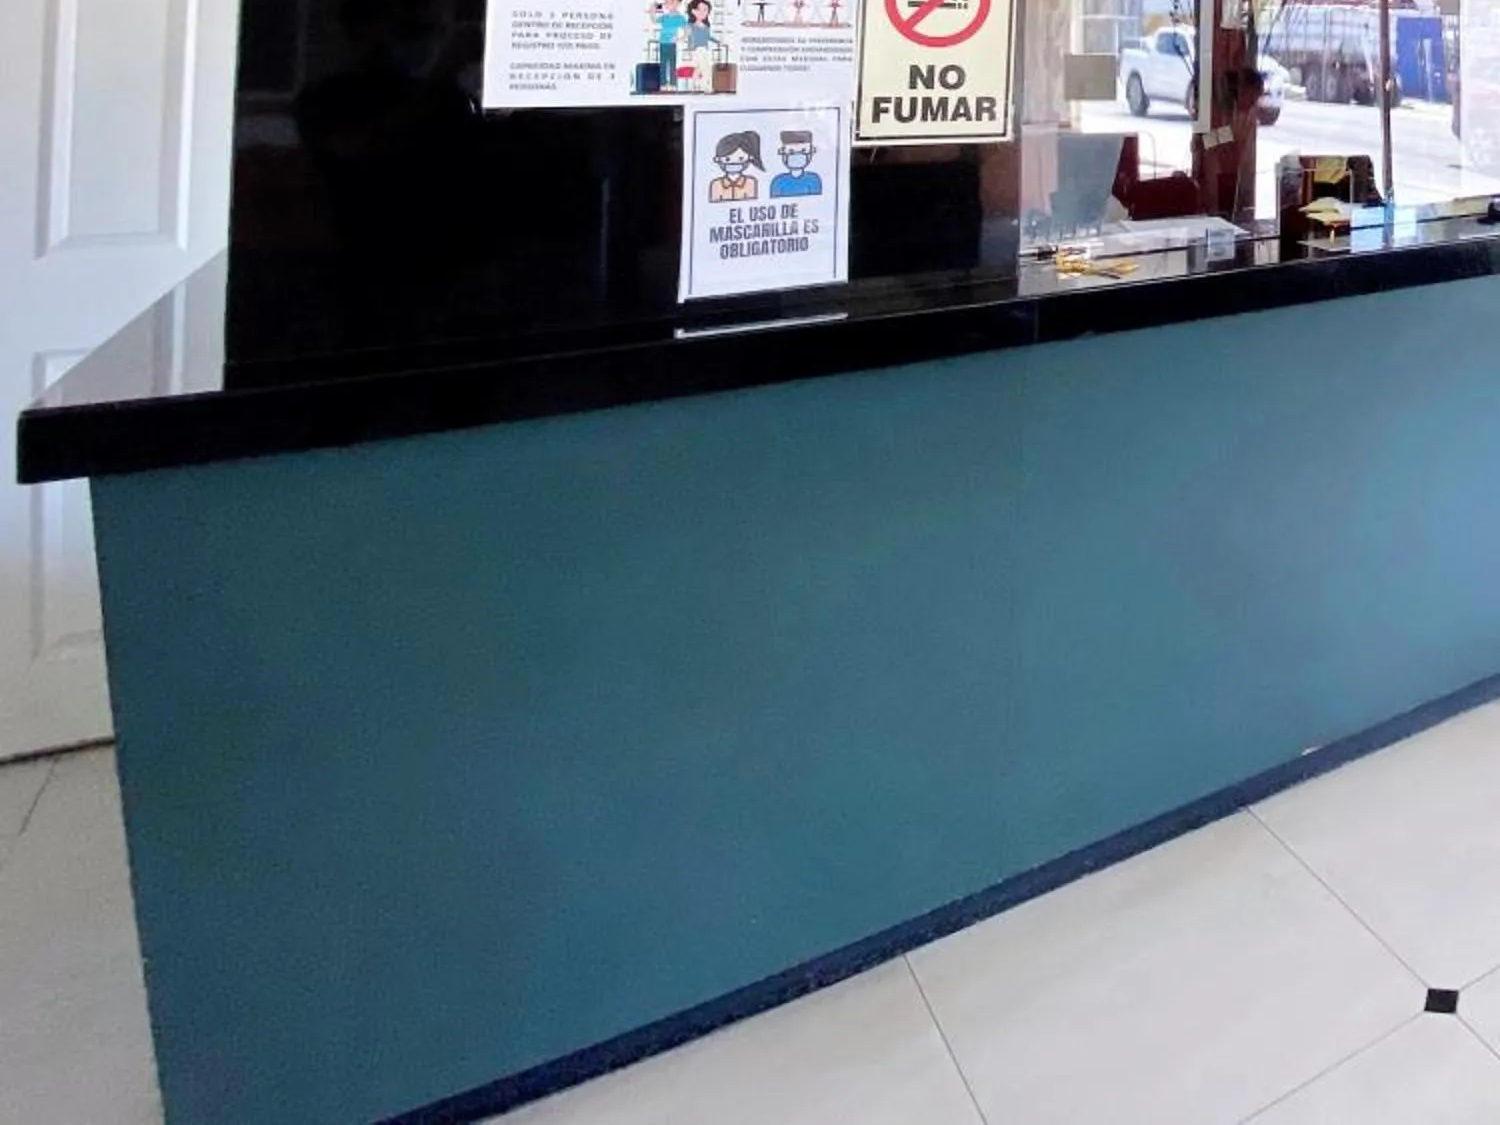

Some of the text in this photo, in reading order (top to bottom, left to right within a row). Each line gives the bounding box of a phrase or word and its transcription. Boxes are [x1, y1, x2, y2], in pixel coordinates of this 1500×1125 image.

[908, 64, 966, 90] NO
[871, 96, 997, 123] FUMAR
[729, 203, 798, 224] EL USO DE
[709, 218, 819, 243] MASCARILLA ES
[720, 236, 809, 259] OBLIGATORIO
